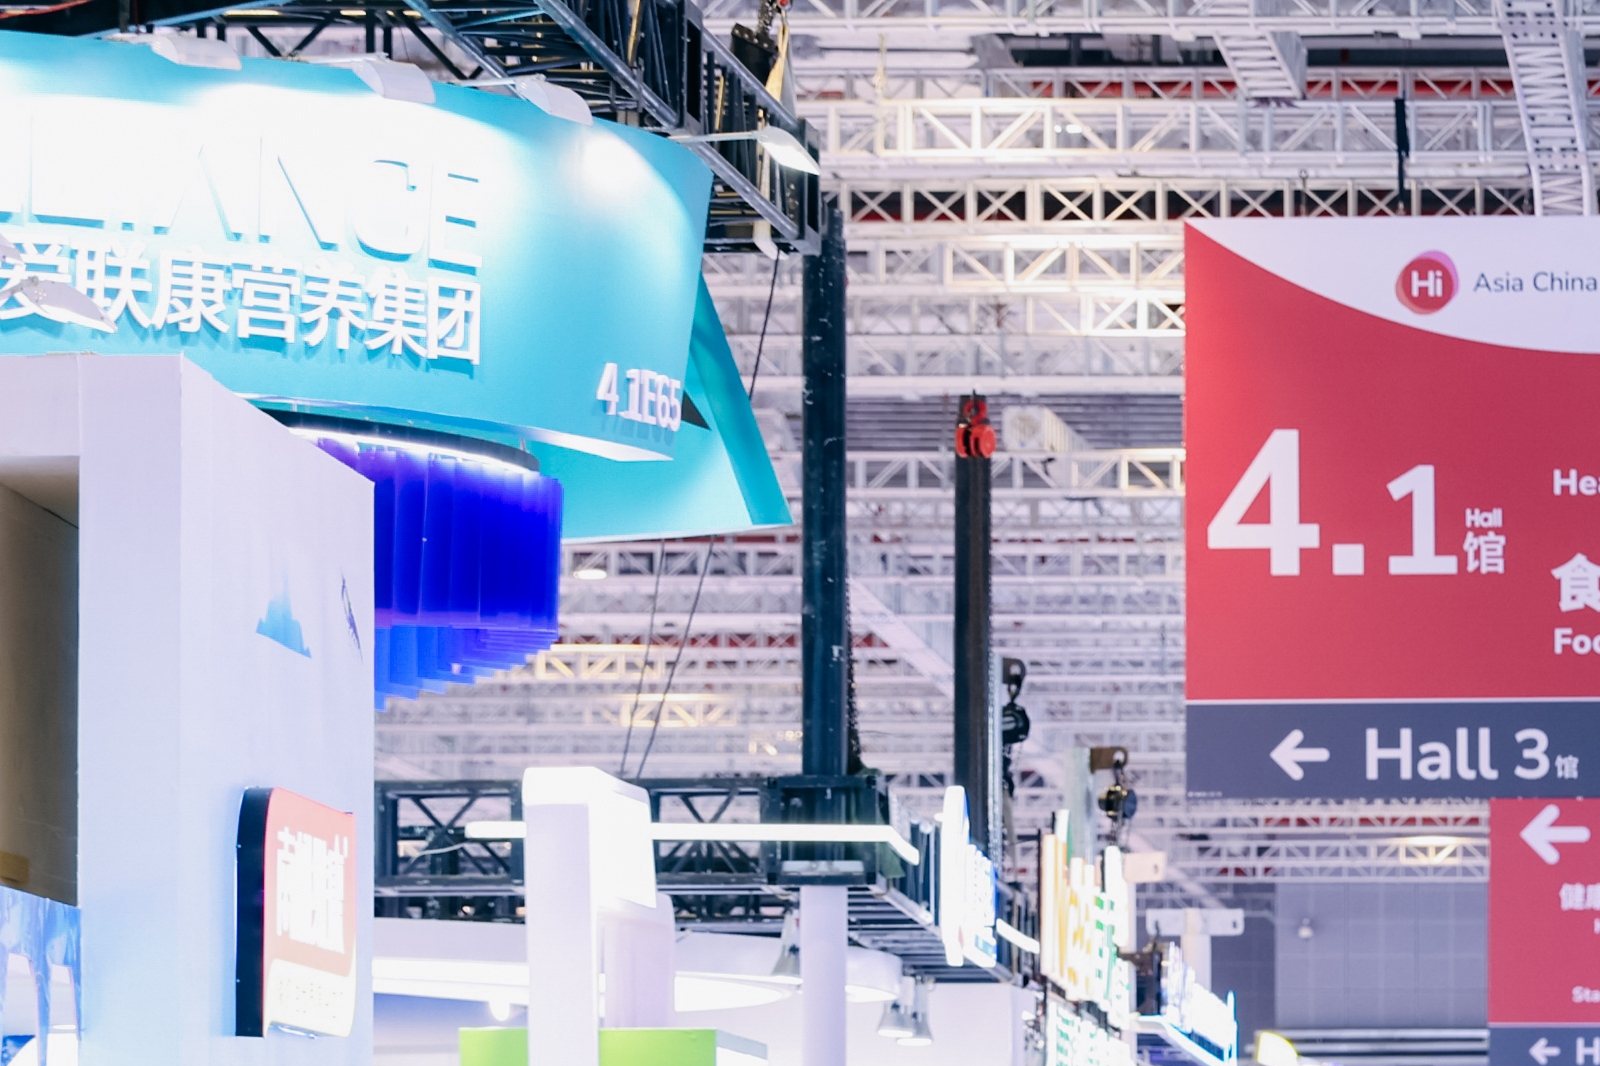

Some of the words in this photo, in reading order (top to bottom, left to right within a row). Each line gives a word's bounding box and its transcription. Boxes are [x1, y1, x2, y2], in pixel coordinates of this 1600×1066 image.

[1412, 270, 1442, 297] Hi
[1474, 273, 1523, 291] Asia
[1533, 272, 1597, 291] China
[1207, 429, 1457, 576] 4.1
[1466, 508, 1502, 528] Hall
[1463, 531, 1505, 574] 馆
[1366, 727, 1498, 780] Hall
[1514, 729, 1549, 779] 3
